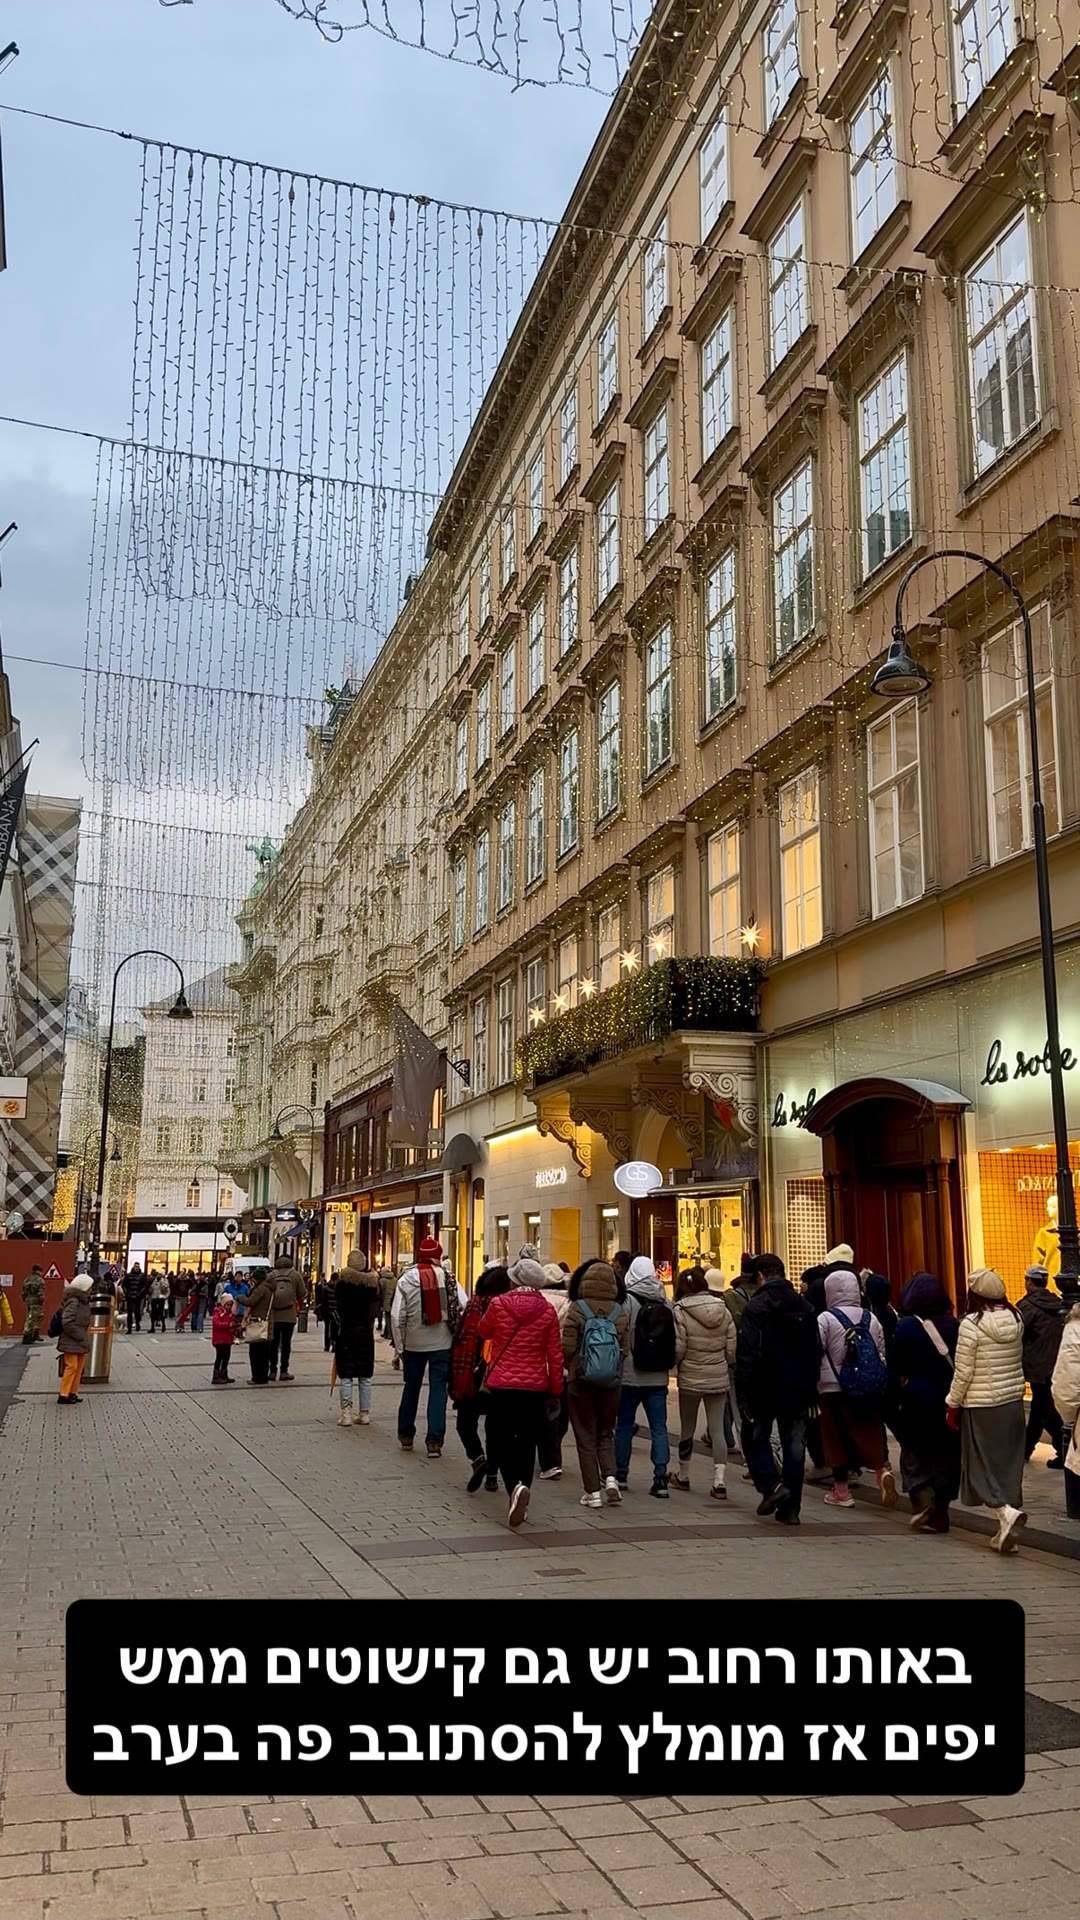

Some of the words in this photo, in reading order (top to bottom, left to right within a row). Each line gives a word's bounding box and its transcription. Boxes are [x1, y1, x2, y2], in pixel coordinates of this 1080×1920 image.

[626, 1165, 649, 1181] GS
[326, 1202, 353, 1212] FENDI
[156, 1223, 189, 1231] WAGNER
